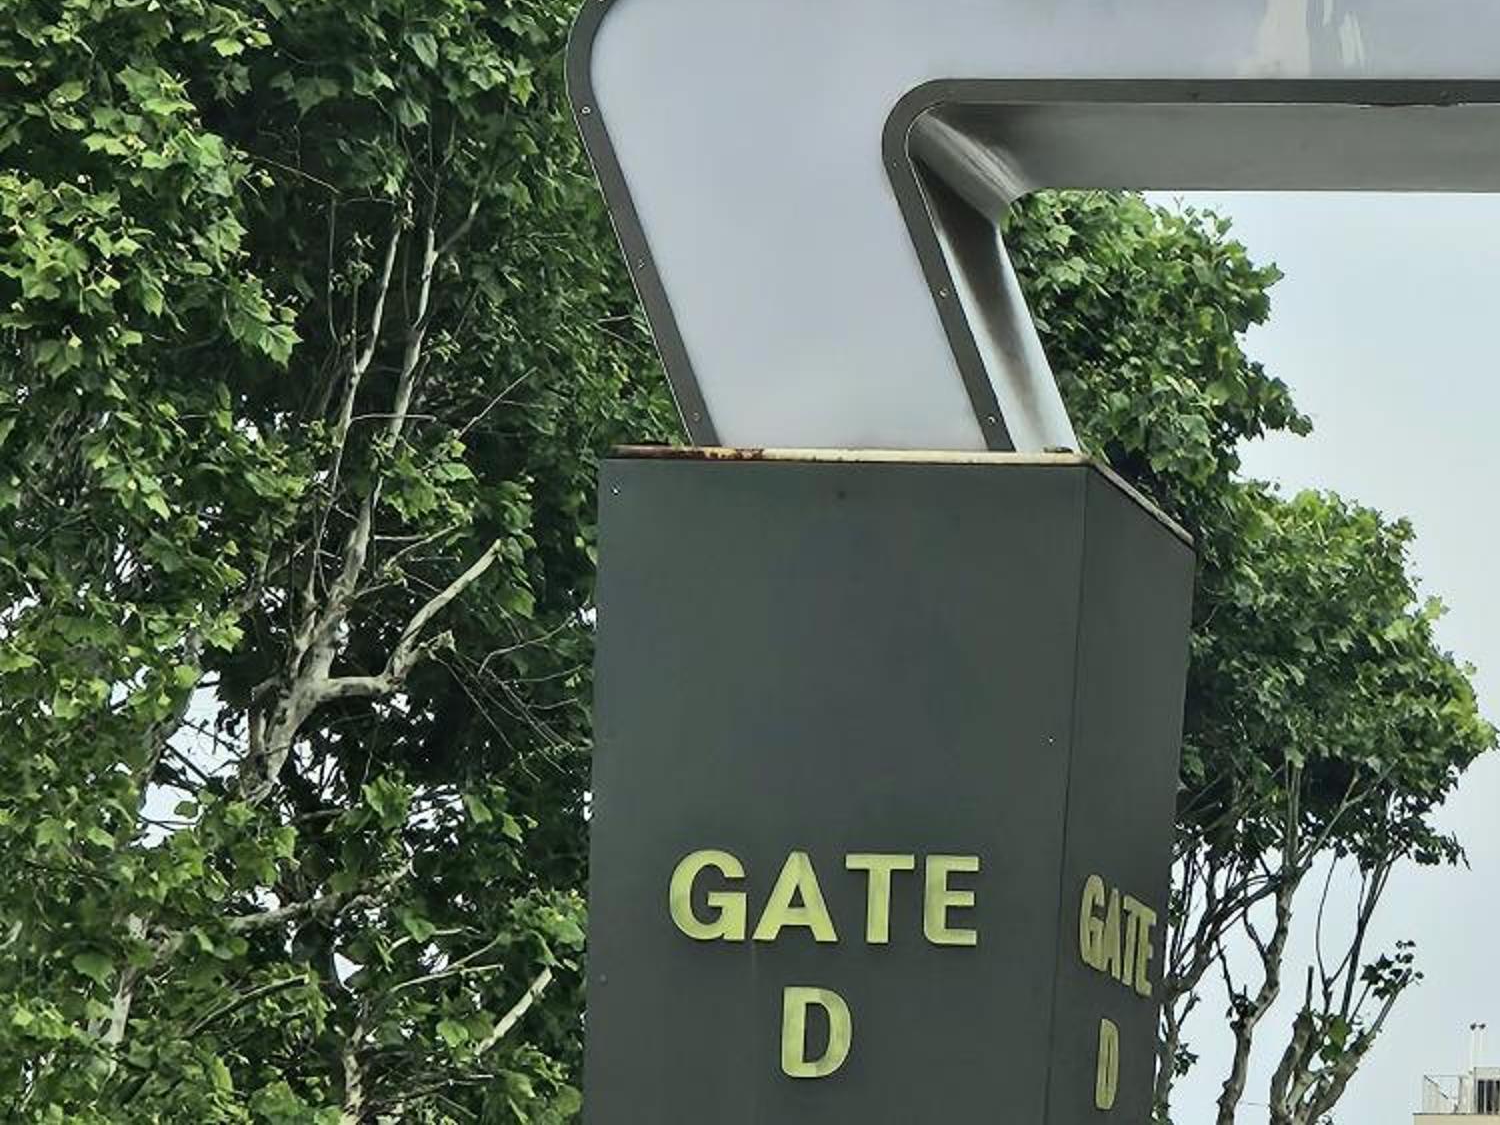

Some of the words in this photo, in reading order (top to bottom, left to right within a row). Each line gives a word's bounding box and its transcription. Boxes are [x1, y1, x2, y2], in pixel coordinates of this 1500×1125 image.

[669, 850, 980, 945] GATE
[1080, 875, 1157, 998] GATE
[781, 987, 852, 1078] D
[1095, 1018, 1120, 1111] D
